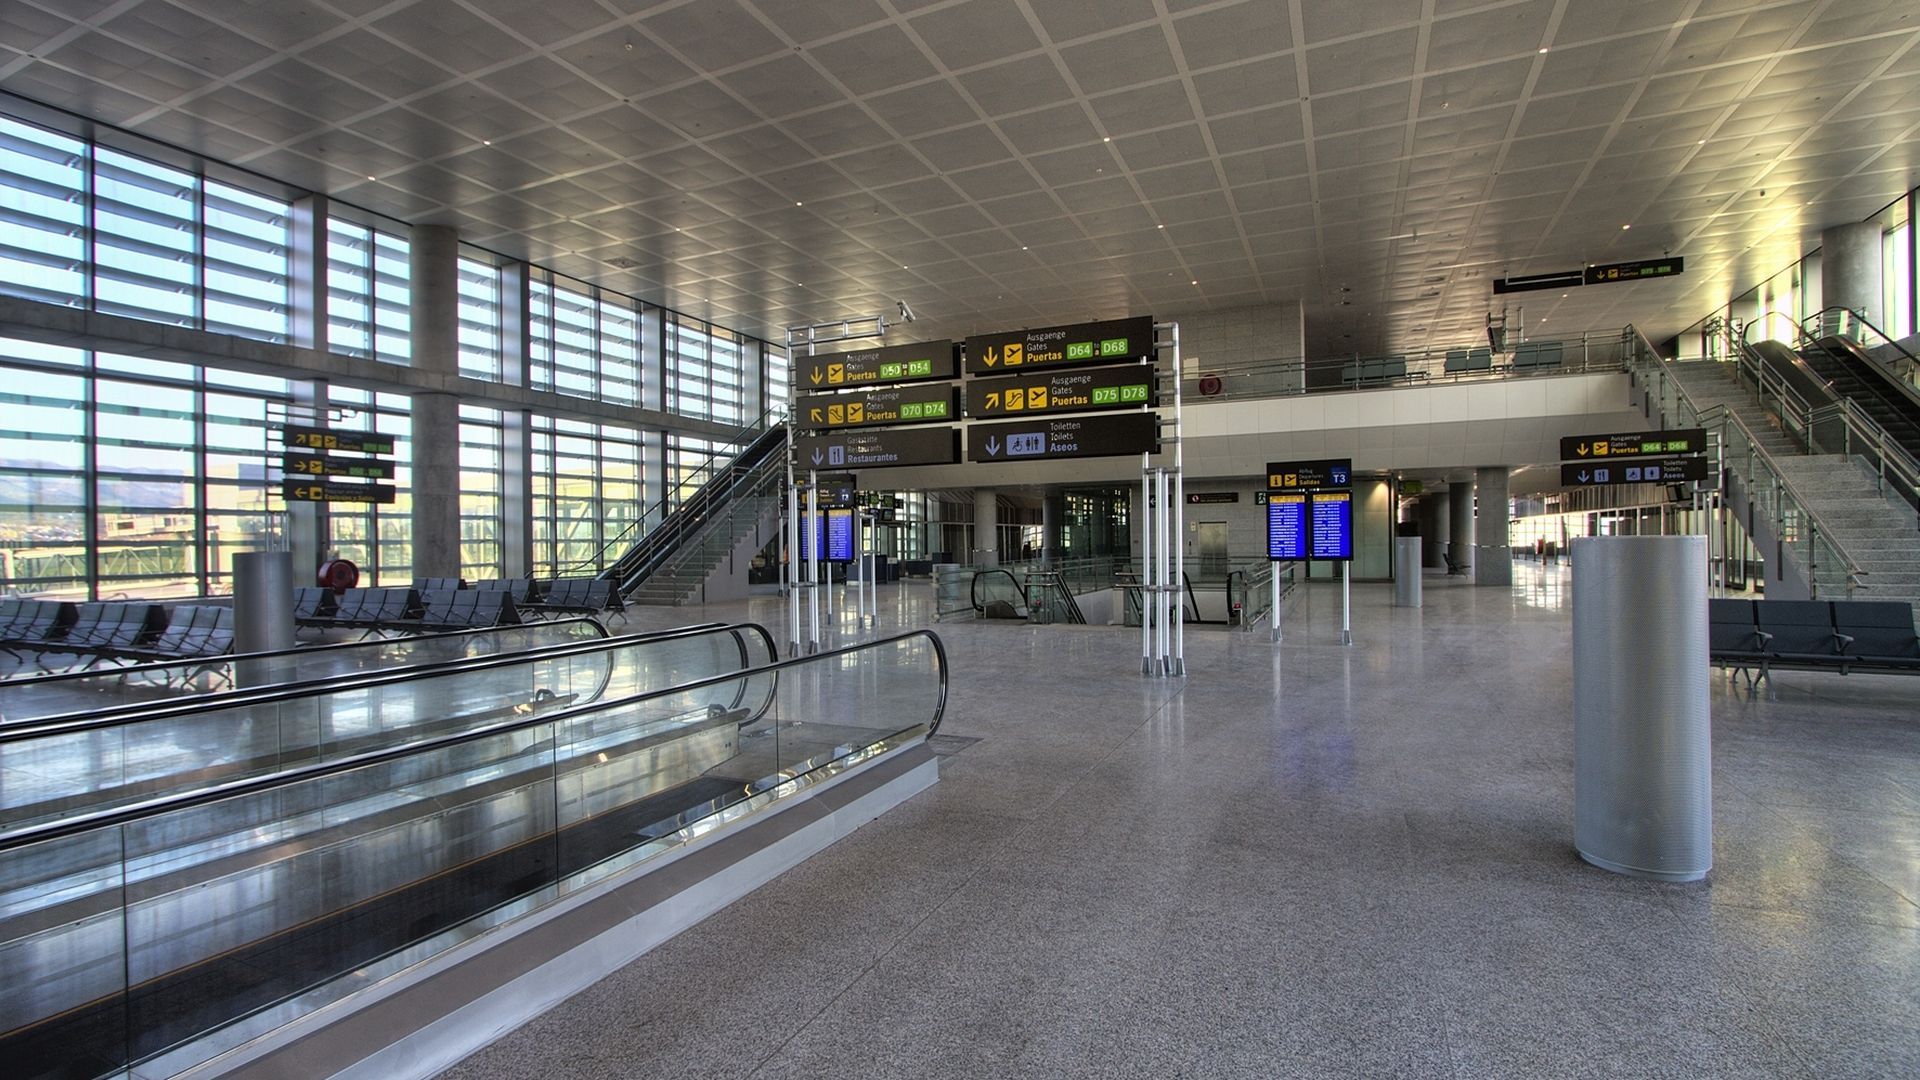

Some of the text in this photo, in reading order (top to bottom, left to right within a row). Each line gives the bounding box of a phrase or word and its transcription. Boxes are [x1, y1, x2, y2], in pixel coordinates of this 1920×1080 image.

[1026, 330, 1067, 342] Ausgaenge
[1026, 342, 1048, 351] Gates
[1027, 341, 1126, 362] Puertas D64 D68
[846, 352, 880, 362] Ausgaenge
[846, 362, 865, 370] Gates
[847, 361, 929, 381] Puertas D50 D54
[1051, 374, 1092, 386] Ausgaenge
[1051, 386, 1073, 395] Gates
[866, 391, 900, 402] Ausgaenge
[1052, 387, 1146, 407] Puertas D75 D78
[866, 402, 884, 410] Gates
[867, 402, 944, 421] Puertas D70 D74
[1050, 421, 1081, 432] Toiletten
[1050, 432, 1074, 441] Toilets
[847, 444, 883, 454] Restaurants
[1050, 443, 1078, 452] Aseos
[1611, 446, 1639, 454] Puertas
[848, 453, 898, 464] Restaurantes
[1332, 473, 1346, 484] T3
